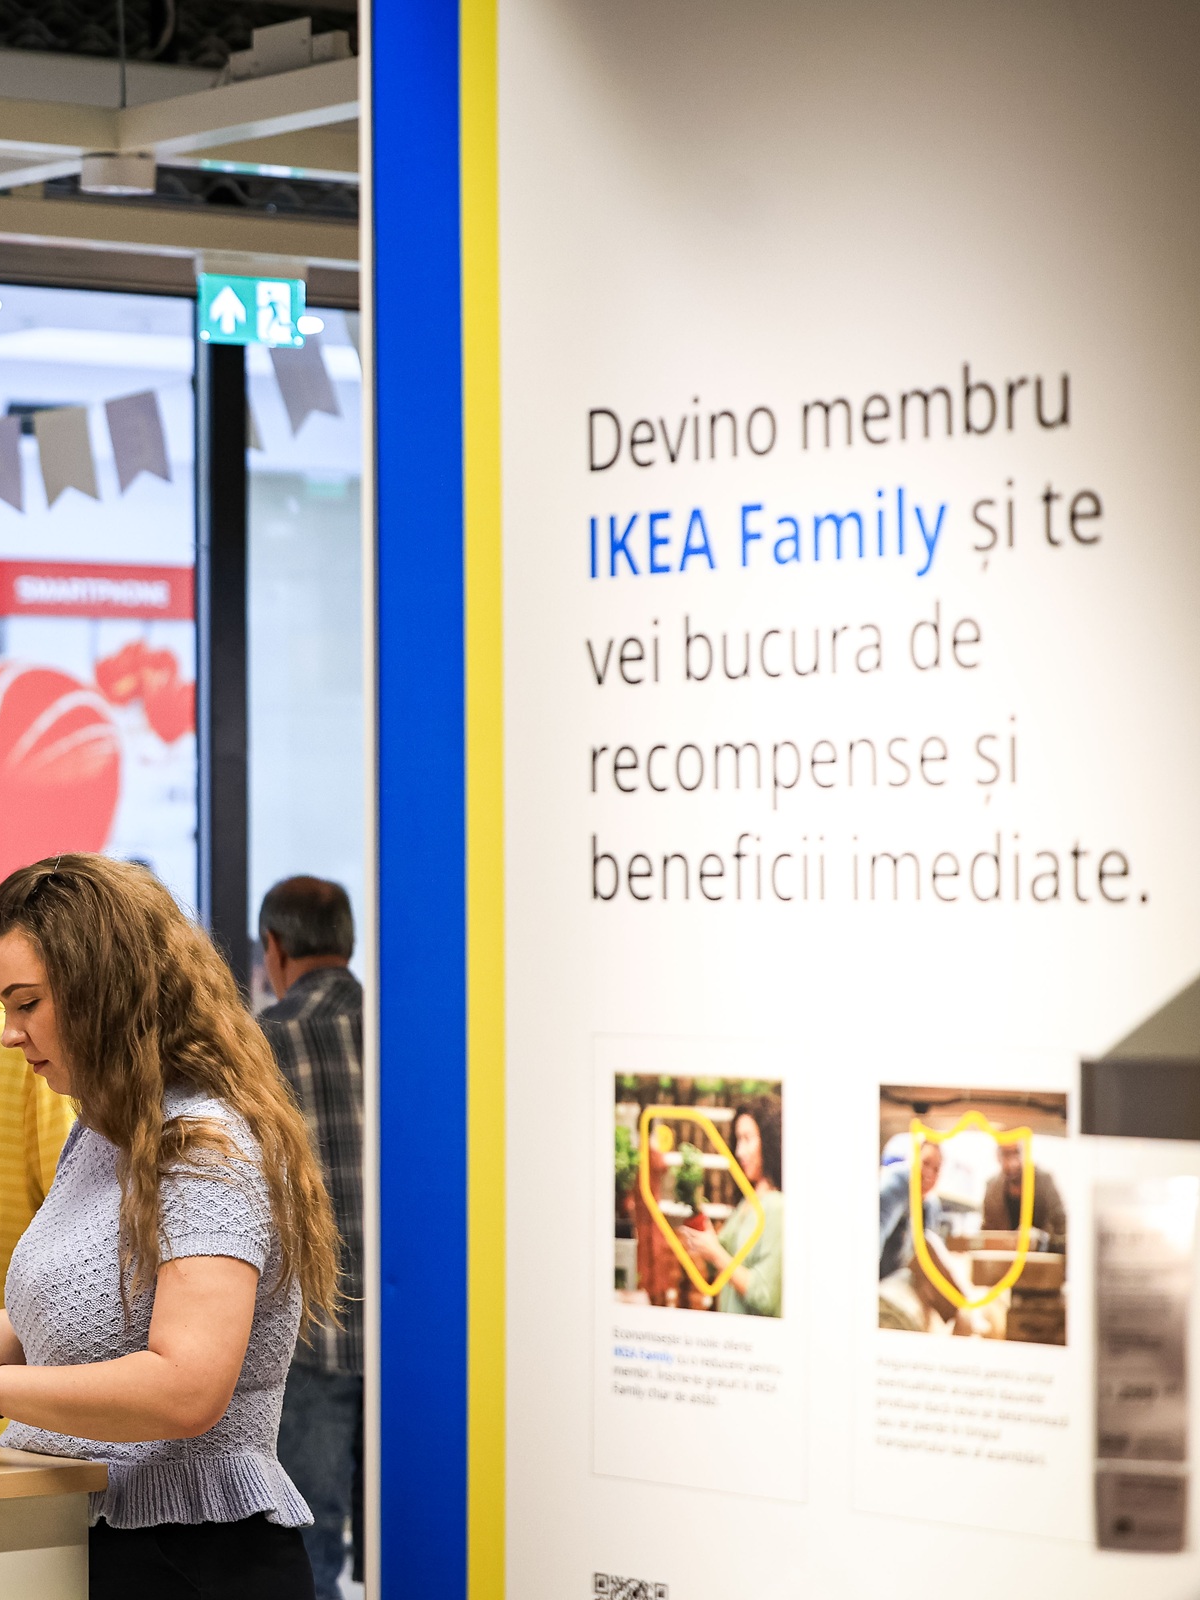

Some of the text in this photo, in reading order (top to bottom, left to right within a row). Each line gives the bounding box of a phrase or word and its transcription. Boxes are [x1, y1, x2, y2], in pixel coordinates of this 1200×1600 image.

[585, 360, 1072, 475] Devino membru
[588, 476, 1105, 580] IKEA Family și te
[14, 575, 170, 607] SMARTPHONE
[583, 597, 985, 688] vei bucura de
[587, 712, 1020, 813] recompense și
[587, 829, 1152, 909] beneficii imediate.
